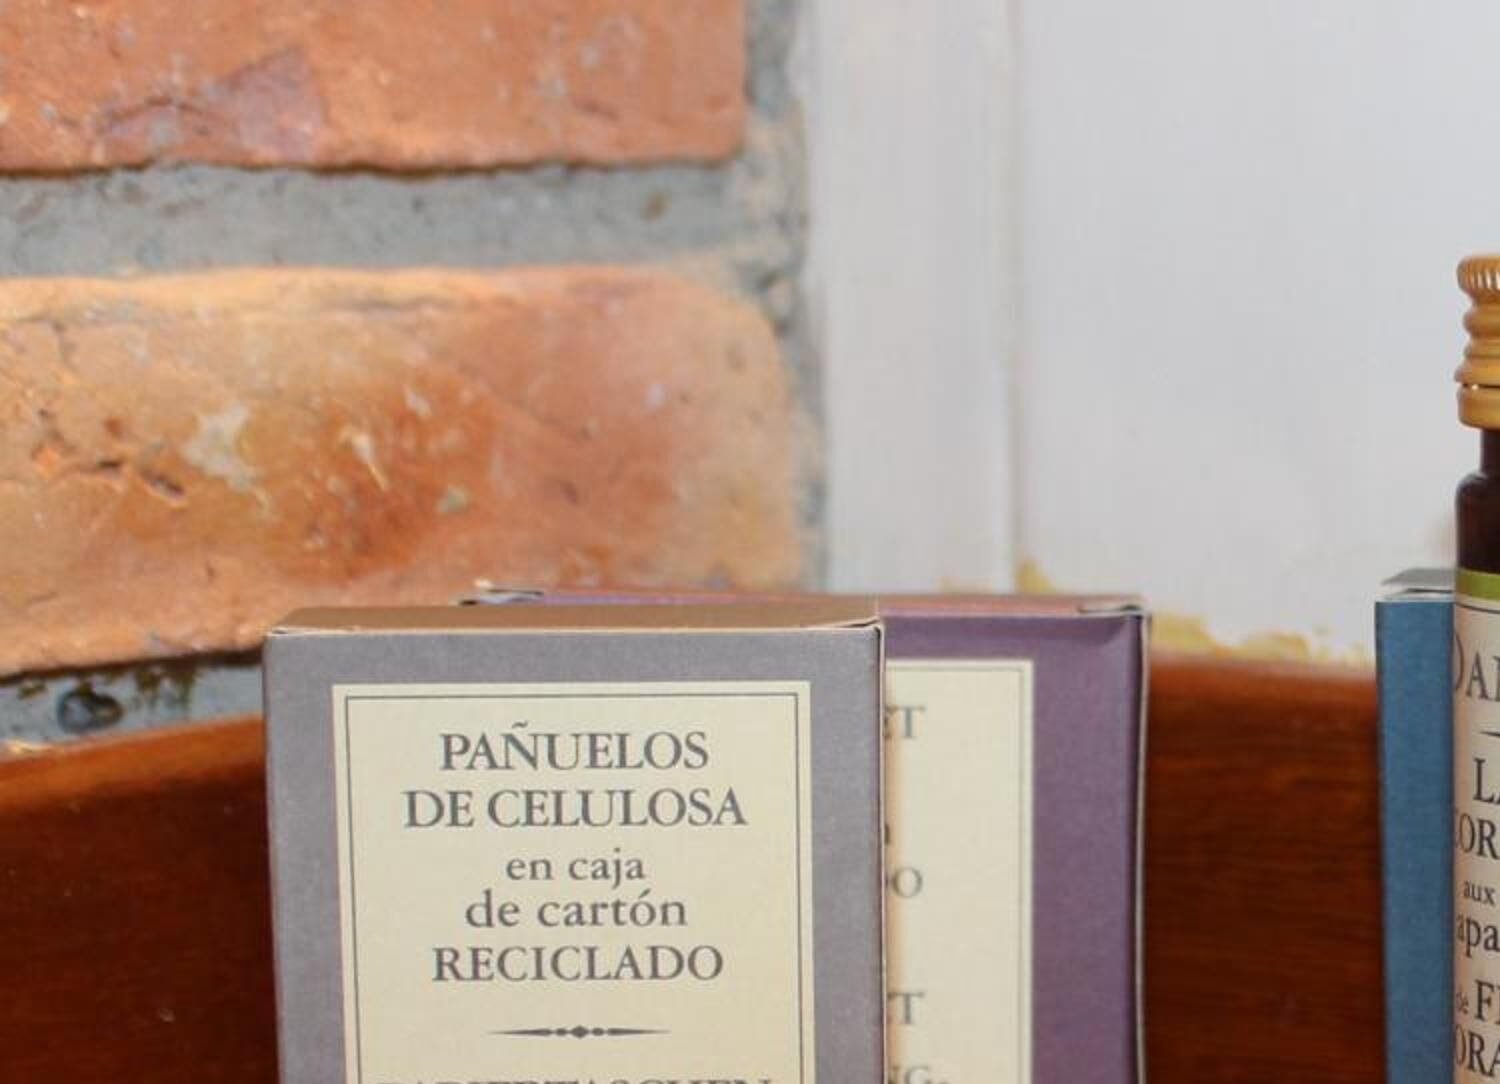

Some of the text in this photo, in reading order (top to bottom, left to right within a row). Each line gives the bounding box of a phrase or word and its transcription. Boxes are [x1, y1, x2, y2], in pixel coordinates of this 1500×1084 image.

[439, 722, 710, 771] PAÑUELOS
[402, 787, 748, 829] DE CELULOSA
[505, 847, 646, 890] en caja
[465, 890, 687, 929] de cartón
[1463, 880, 1496, 908] aux
[432, 945, 724, 982] RECICLADO
